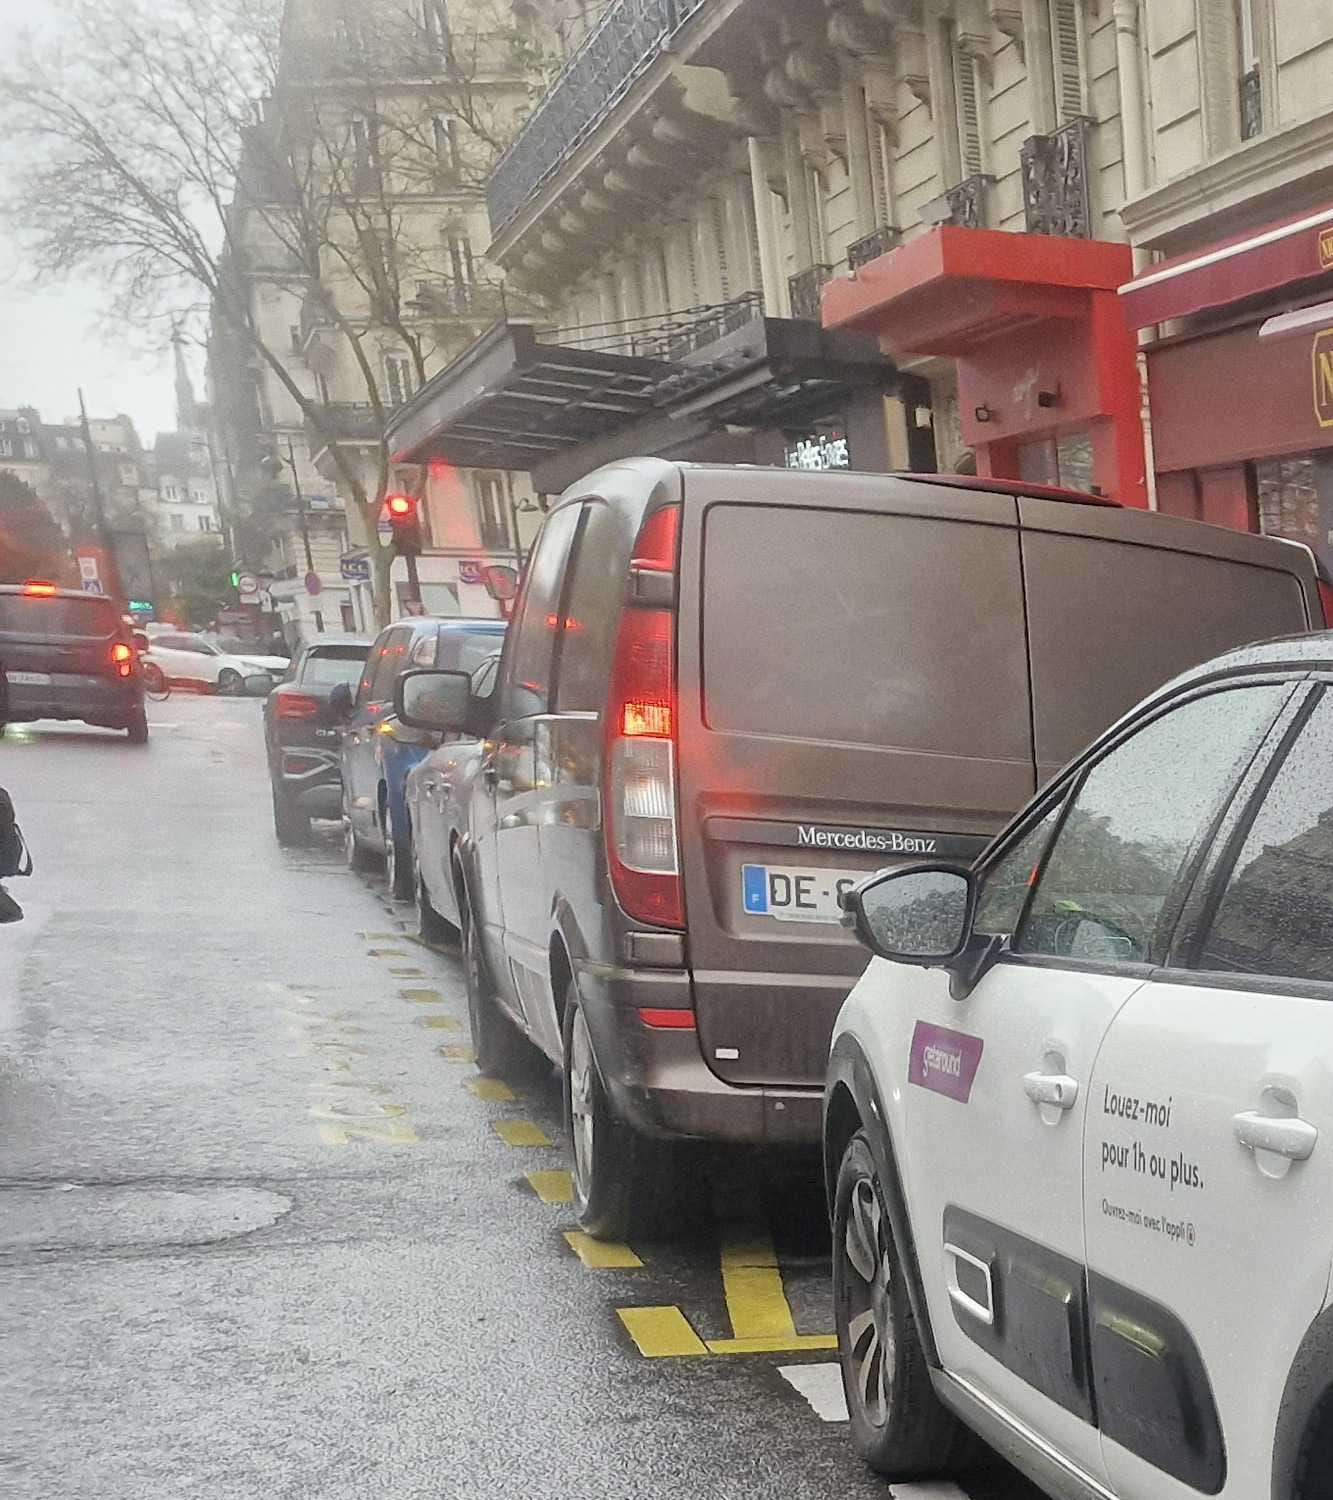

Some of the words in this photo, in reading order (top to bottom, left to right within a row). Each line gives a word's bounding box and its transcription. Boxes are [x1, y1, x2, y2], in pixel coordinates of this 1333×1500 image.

[798, 826, 937, 853] Mercedes-Benz
[923, 1044, 963, 1078] getaround
[1103, 1084, 1173, 1128] Louez-moi
[1102, 1141, 1129, 1172] pour
[1133, 1141, 1146, 1174] 1h
[1150, 1154, 1166, 1179] ou
[1170, 1151, 1204, 1192] plus.
[1143, 1215, 1161, 1232] avec
